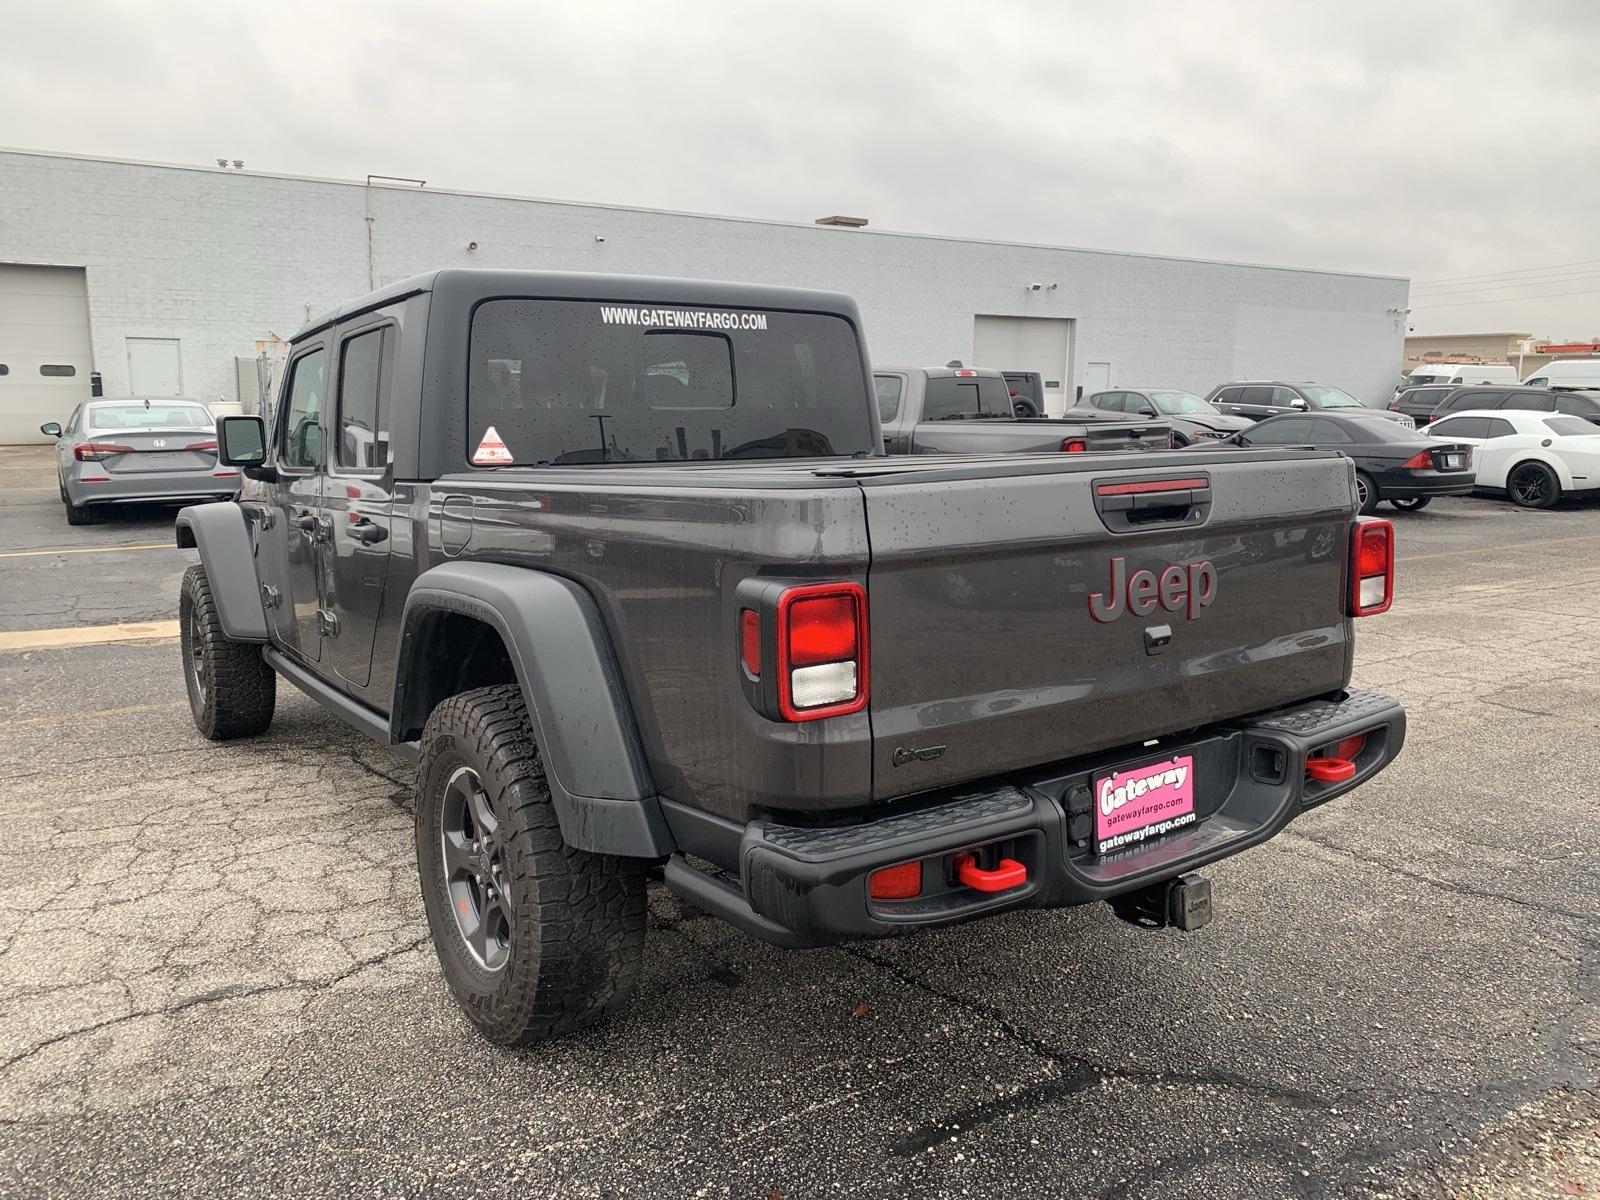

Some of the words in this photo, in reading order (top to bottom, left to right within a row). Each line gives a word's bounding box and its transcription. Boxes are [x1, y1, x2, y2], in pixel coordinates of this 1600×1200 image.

[600, 306, 768, 330] WWW.GATEWAYFARGO.COM
[1088, 556, 1218, 623] Jeep
[1100, 765, 1188, 816] Gateway
[1107, 797, 1183, 827] gatewayfargo.com
[1100, 813, 1196, 853] gatewayfargo.com
